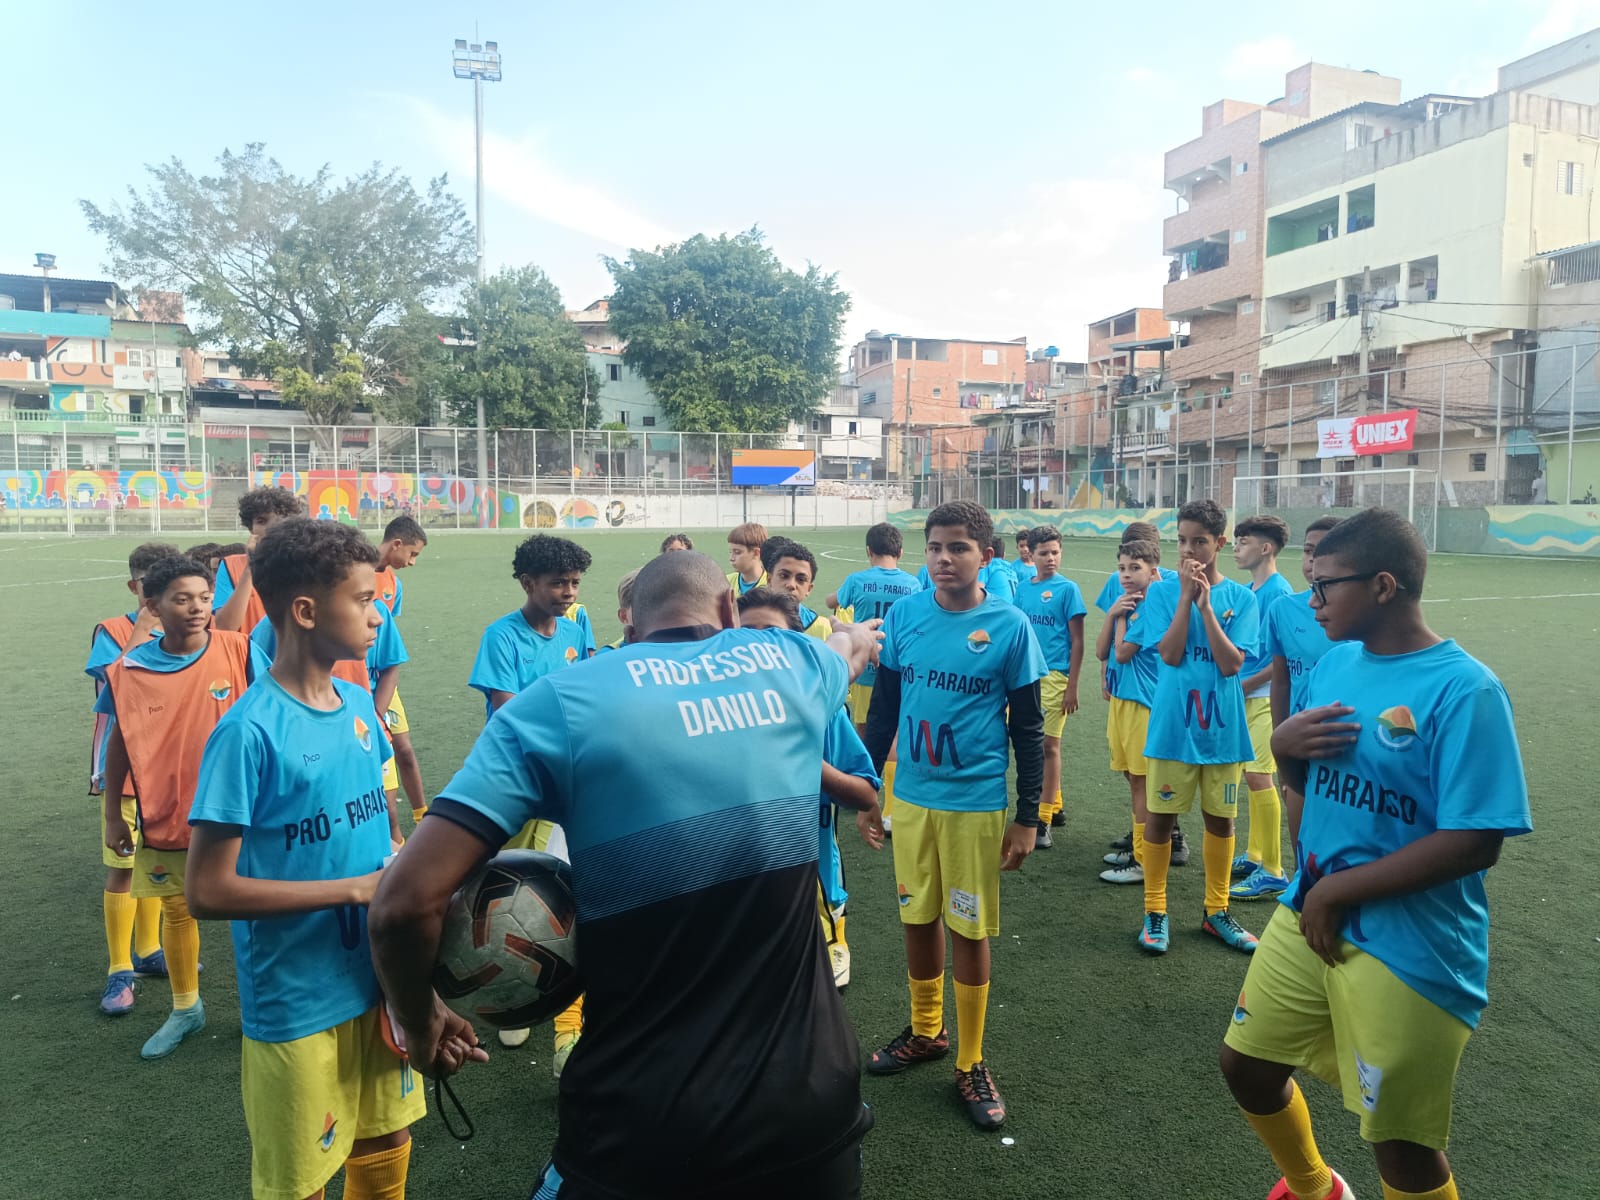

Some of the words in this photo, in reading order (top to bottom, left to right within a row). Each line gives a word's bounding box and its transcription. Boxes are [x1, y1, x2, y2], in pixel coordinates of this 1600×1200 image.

[1356, 418, 1409, 445] UNIEX
[1027, 614, 1055, 627] ARAISO
[625, 642, 792, 688] PROFESSOR
[927, 669, 992, 696] PARAISO
[677, 689, 788, 737] DANILO
[1224, 783, 1236, 804] 10
[1314, 765, 1418, 826] PARAISO
[284, 807, 331, 851] PRÓ
[345, 785, 388, 830] PARAIS
